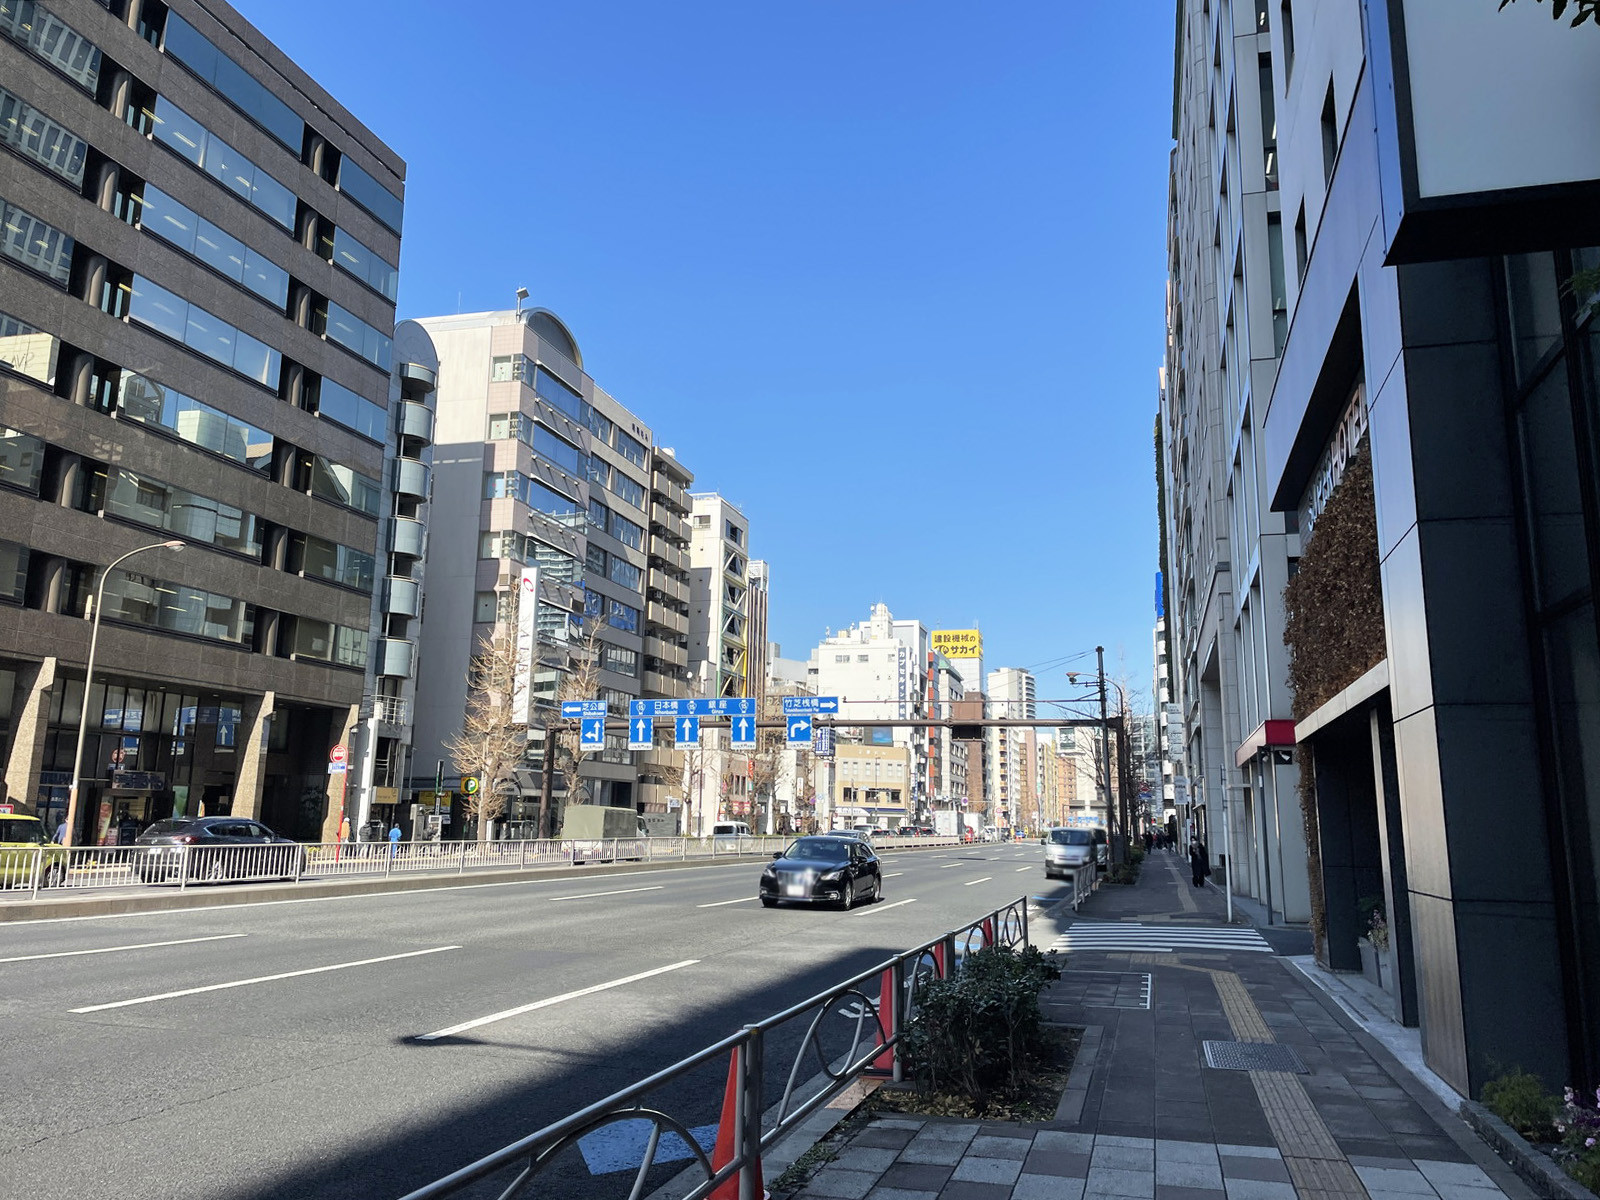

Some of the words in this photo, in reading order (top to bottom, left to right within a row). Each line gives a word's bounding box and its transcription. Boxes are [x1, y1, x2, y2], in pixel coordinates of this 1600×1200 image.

[1331, 382, 1368, 488] HOTEL
[934, 634, 976, 643] 建設機械の
[950, 645, 977, 655] サカイ
[582, 702, 605, 711] 芝公園
[655, 701, 678, 710] 日本橋
[708, 700, 727, 709] 銀座
